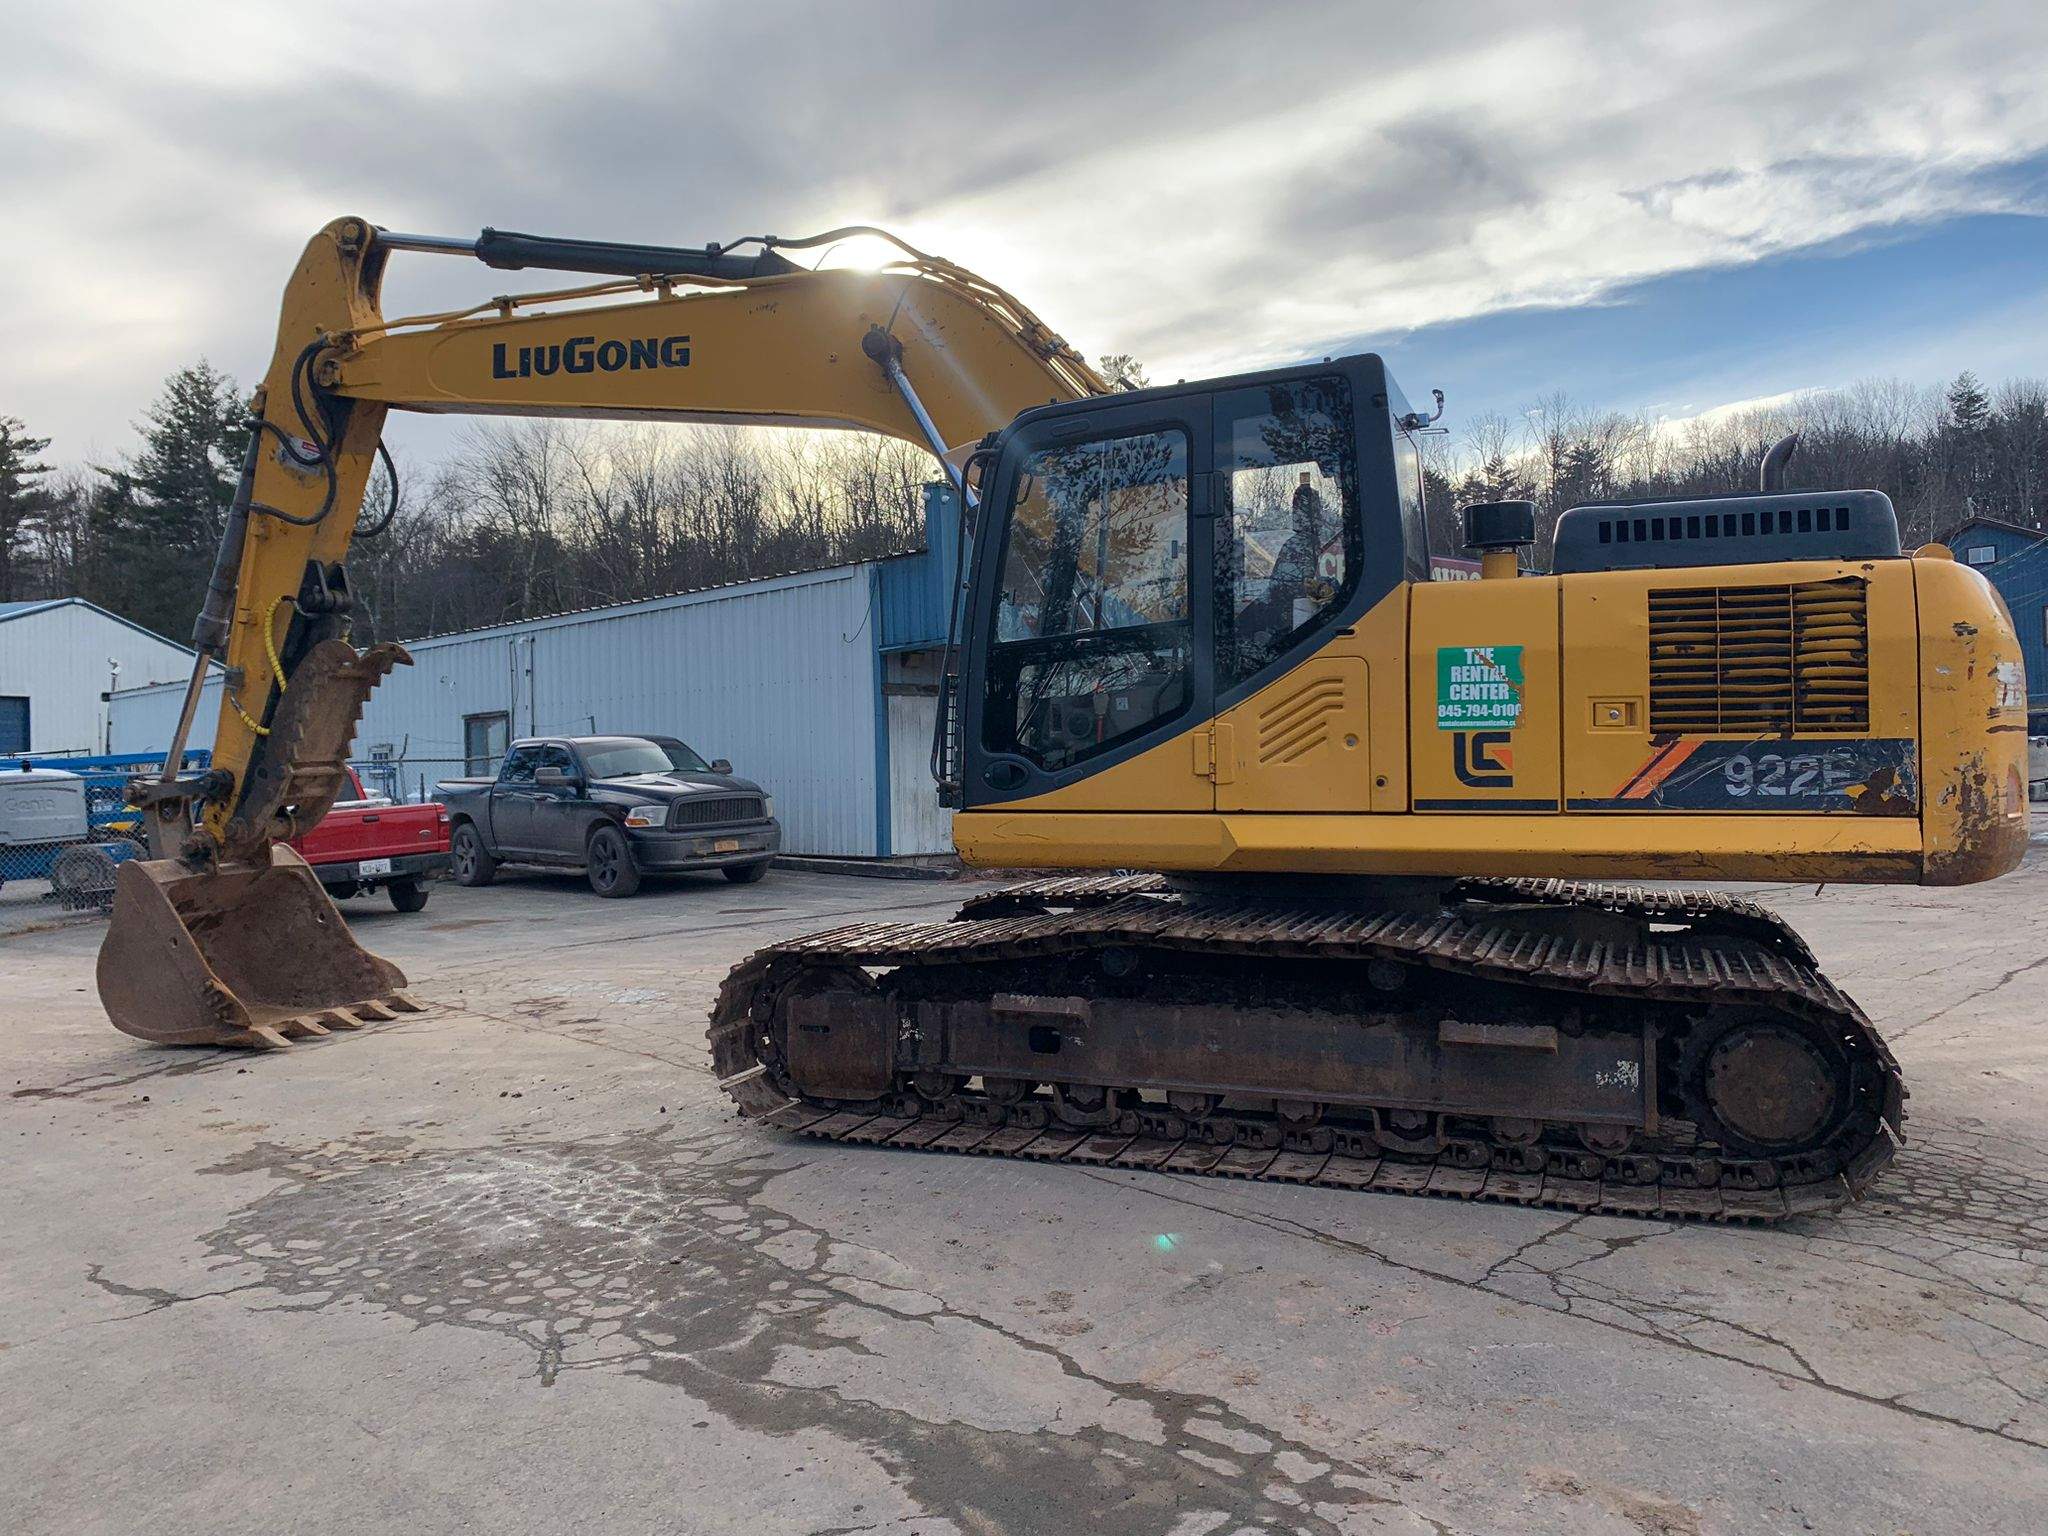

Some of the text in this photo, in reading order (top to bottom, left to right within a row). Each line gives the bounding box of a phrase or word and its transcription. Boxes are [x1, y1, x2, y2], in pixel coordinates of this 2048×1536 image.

[1464, 648, 1495, 664] THE
[1451, 665, 1507, 682] RENTAL
[1449, 684, 1509, 700] CENTER
